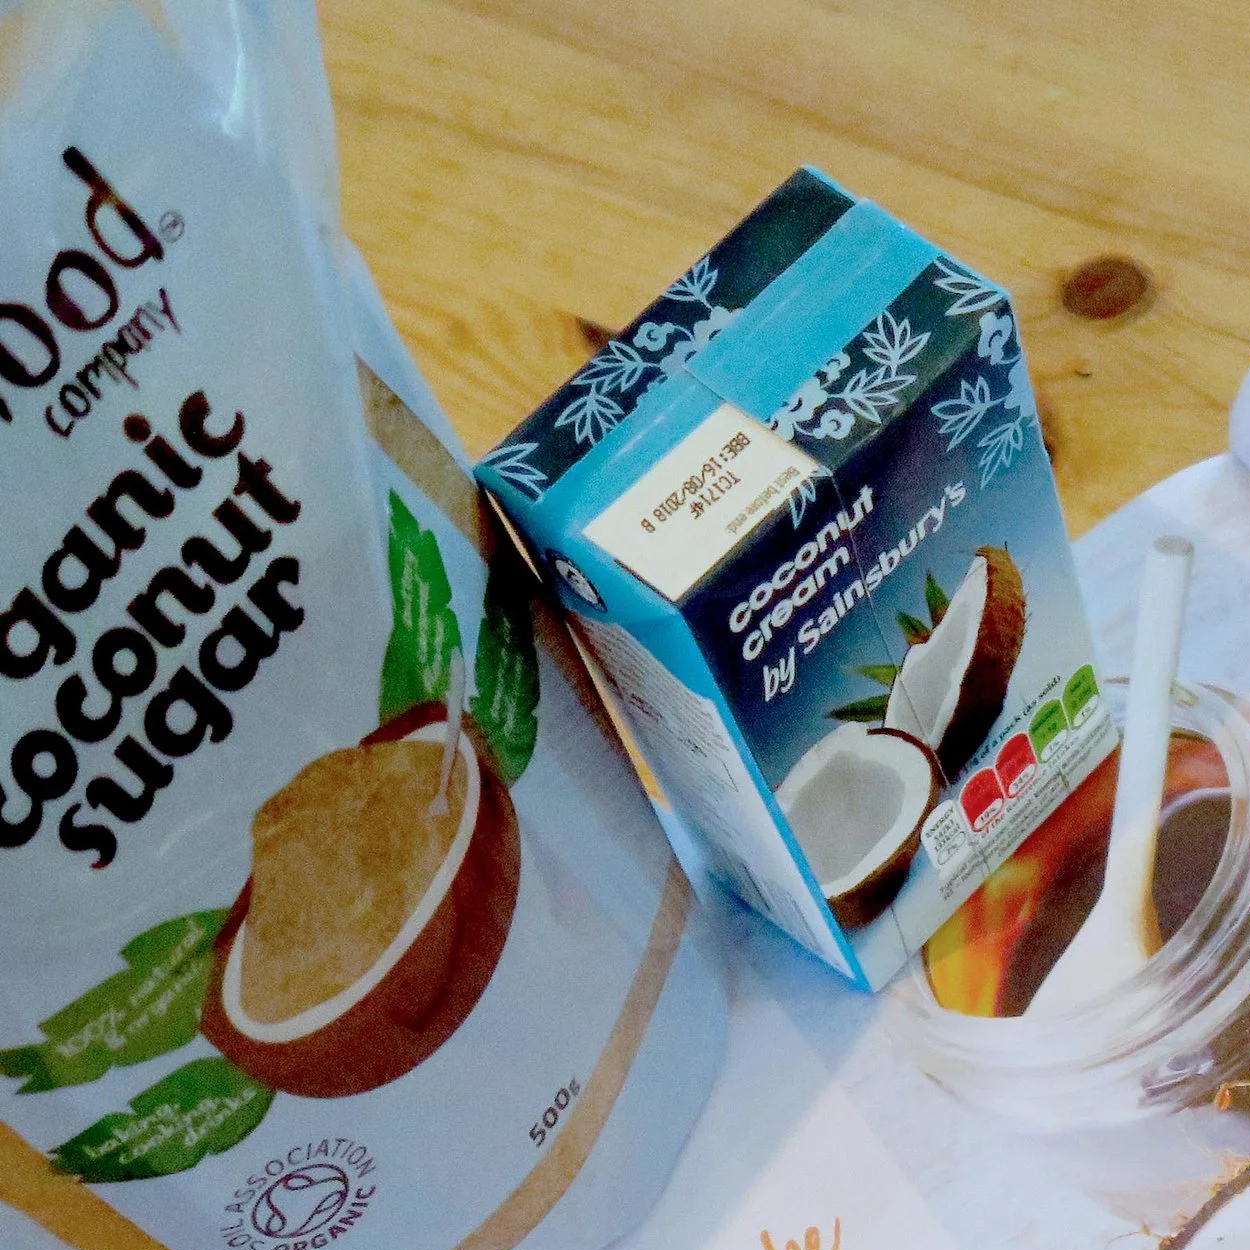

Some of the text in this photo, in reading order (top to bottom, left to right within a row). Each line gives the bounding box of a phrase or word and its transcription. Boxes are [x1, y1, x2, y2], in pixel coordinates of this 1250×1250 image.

[0, 146, 163, 423] ood
[46, 287, 182, 439] company
[729, 485, 874, 633] coconut
[741, 545, 851, 661] cream
[763, 480, 967, 702] by Sainsbury's
[0, 451, 301, 848] coconut
[59, 555, 304, 870] sugar
[224, 1137, 377, 1214] ASSOCIATION
[529, 1078, 582, 1149] 500g
